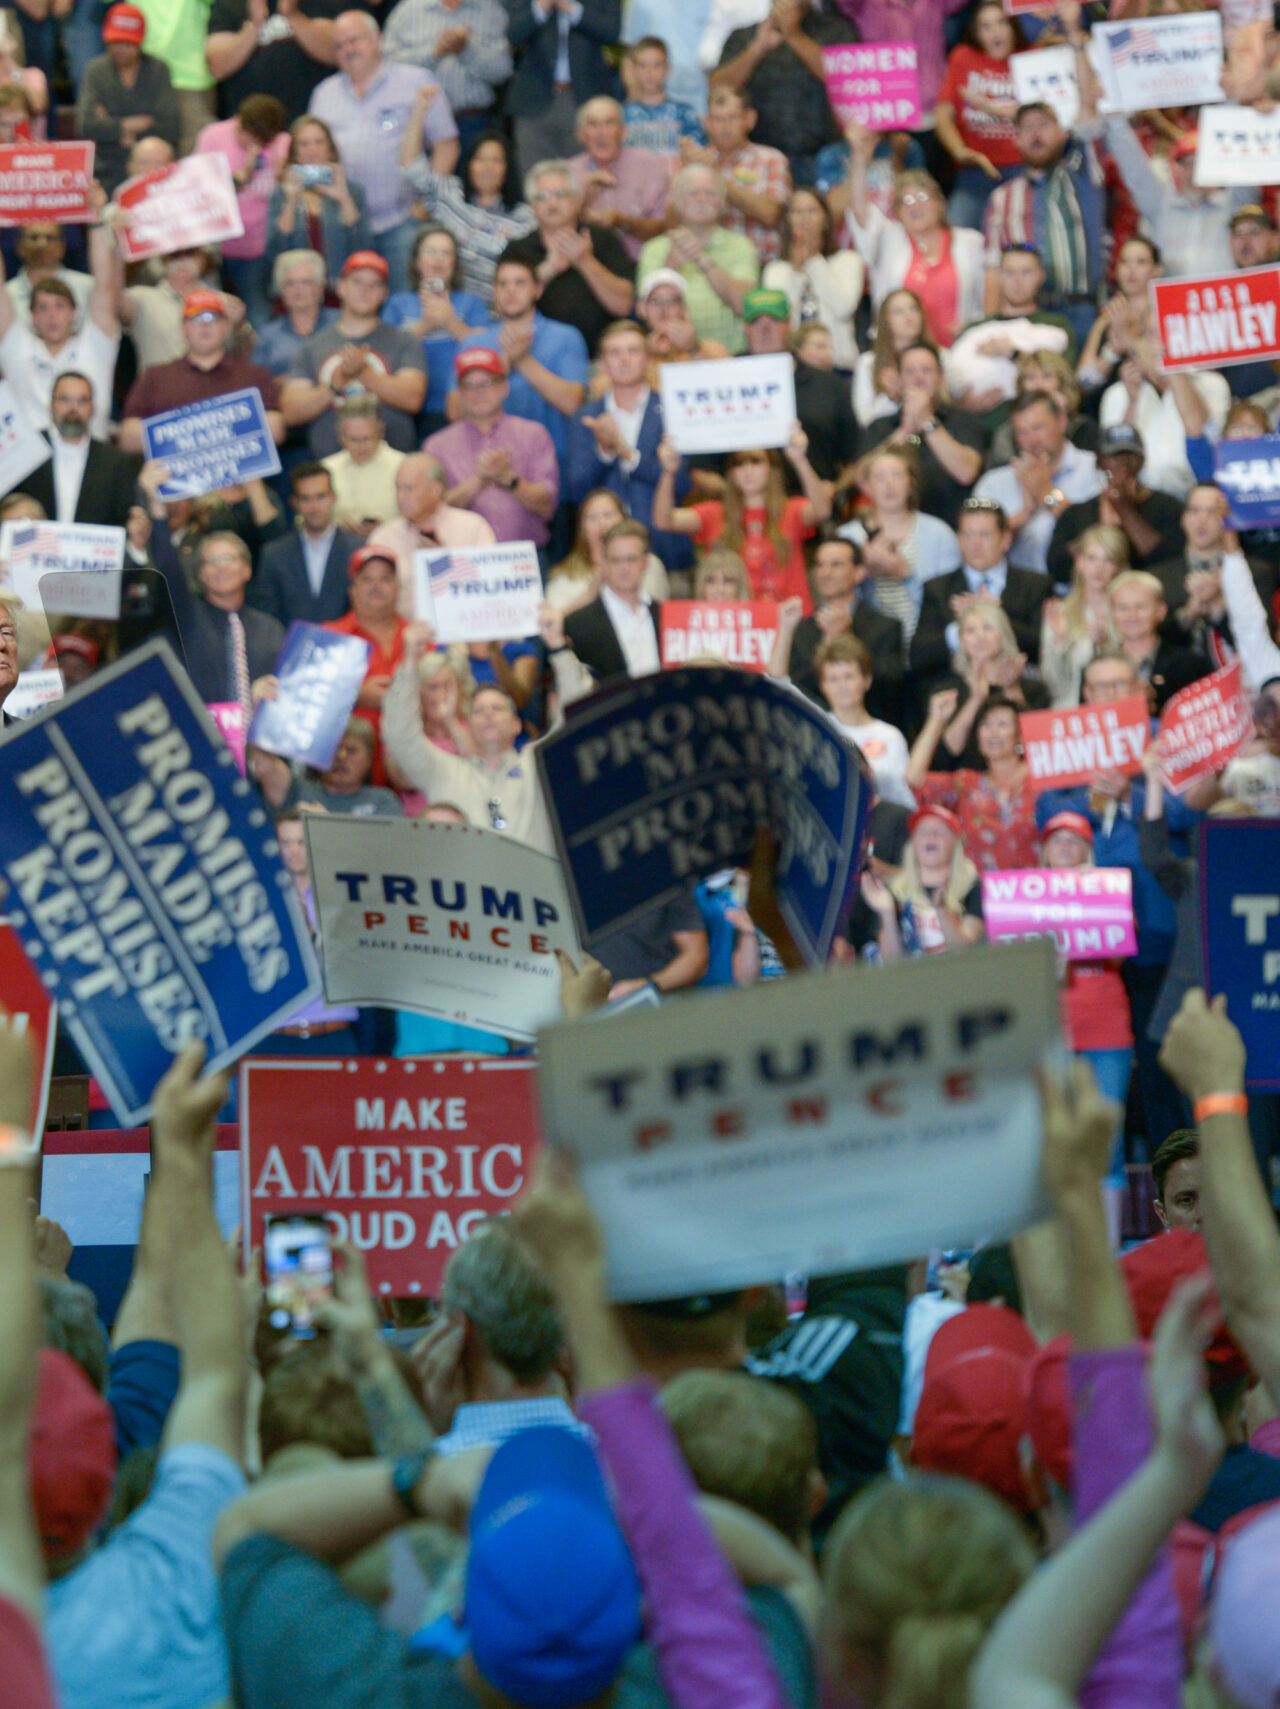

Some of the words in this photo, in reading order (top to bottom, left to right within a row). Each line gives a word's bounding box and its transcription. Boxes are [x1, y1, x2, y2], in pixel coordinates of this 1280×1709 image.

[822, 46, 917, 74] WOMEN
[842, 77, 881, 96] FOR
[1163, 301, 1277, 359] HAWLEY
[676, 381, 781, 402] TRUMP
[153, 401, 253, 445] PROMISES
[31, 552, 117, 573] TRUMP
[449, 577, 538, 597] TRUMP
[689, 609, 753, 629] JOSH
[664, 627, 777, 665] HAWLEY
[1051, 709, 1119, 738] JOSH
[1028, 722, 1146, 779] HAWLEY
[117, 693, 291, 995] PROMISES
[108, 780, 235, 964] MADE
[986, 872, 1131, 901] WOMEN
[16, 755, 213, 1054] PROMISES
[335, 871, 560, 927] TRUMP
[1032, 903, 1084, 923] FOR
[6, 845, 130, 1001] KEPT
[364, 911, 551, 954] PENCE
[358, 938, 398, 951] MAKE
[404, 942, 464, 961] AMERICA
[468, 951, 510, 969] GREAT
[590, 1005, 1014, 1116] TRUMP
[354, 1097, 468, 1131] MAKE
[633, 1068, 981, 1152] PENCE
[252, 1142, 525, 1199] AMERIC
[324, 1209, 417, 1250] OUD
